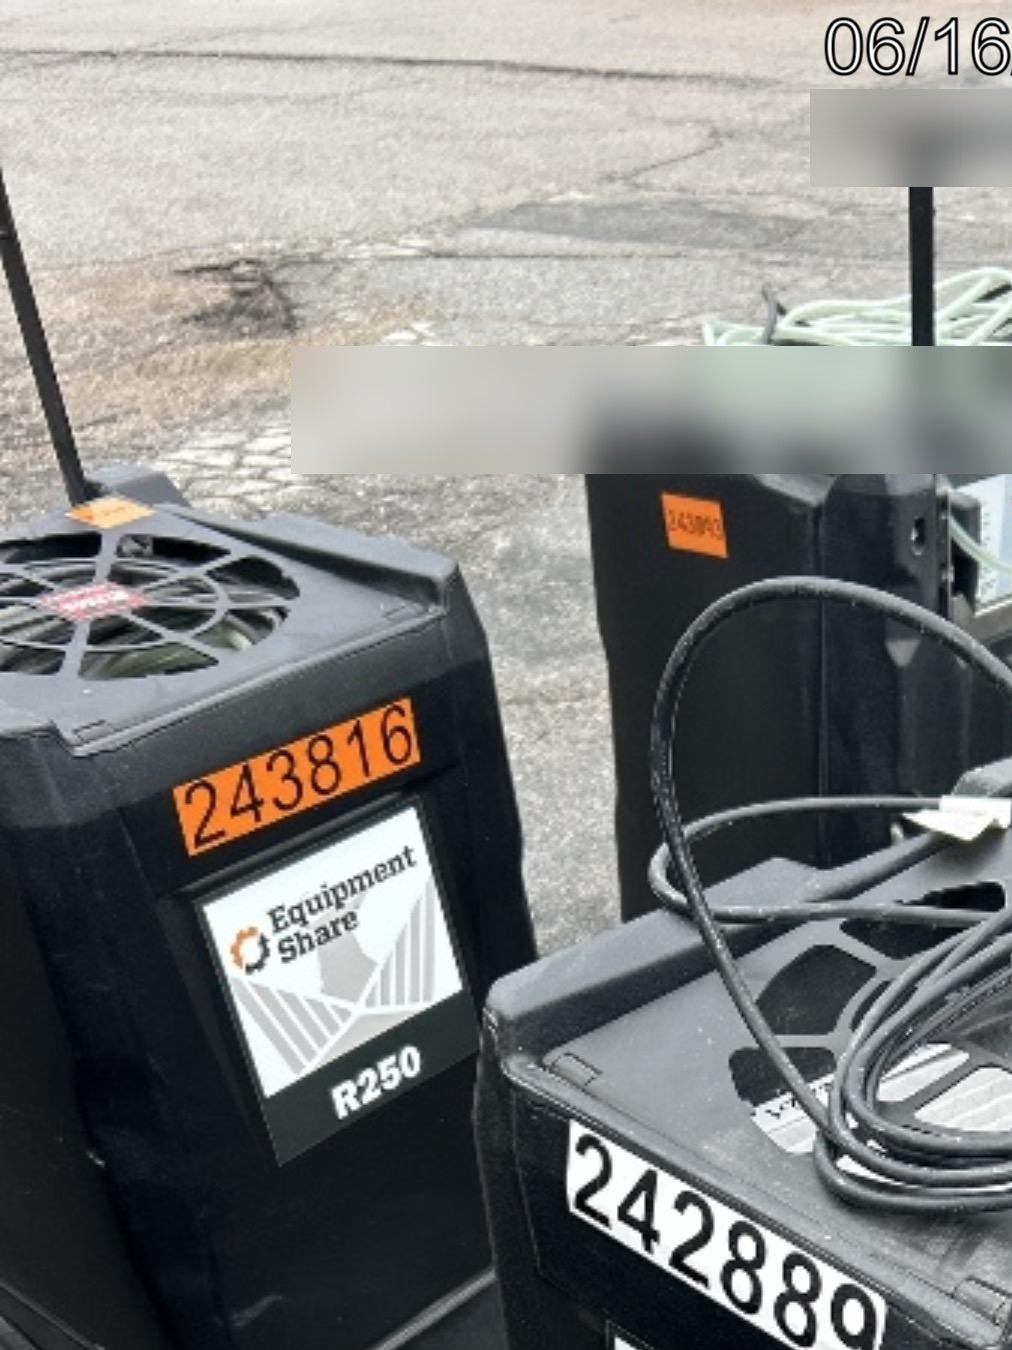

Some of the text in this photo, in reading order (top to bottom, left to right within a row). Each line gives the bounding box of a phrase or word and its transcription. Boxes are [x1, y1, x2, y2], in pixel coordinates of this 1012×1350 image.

[183, 703, 413, 849] 243816
[266, 845, 418, 935] Equipment
[277, 908, 359, 964] Share
[330, 1044, 422, 1120] R250
